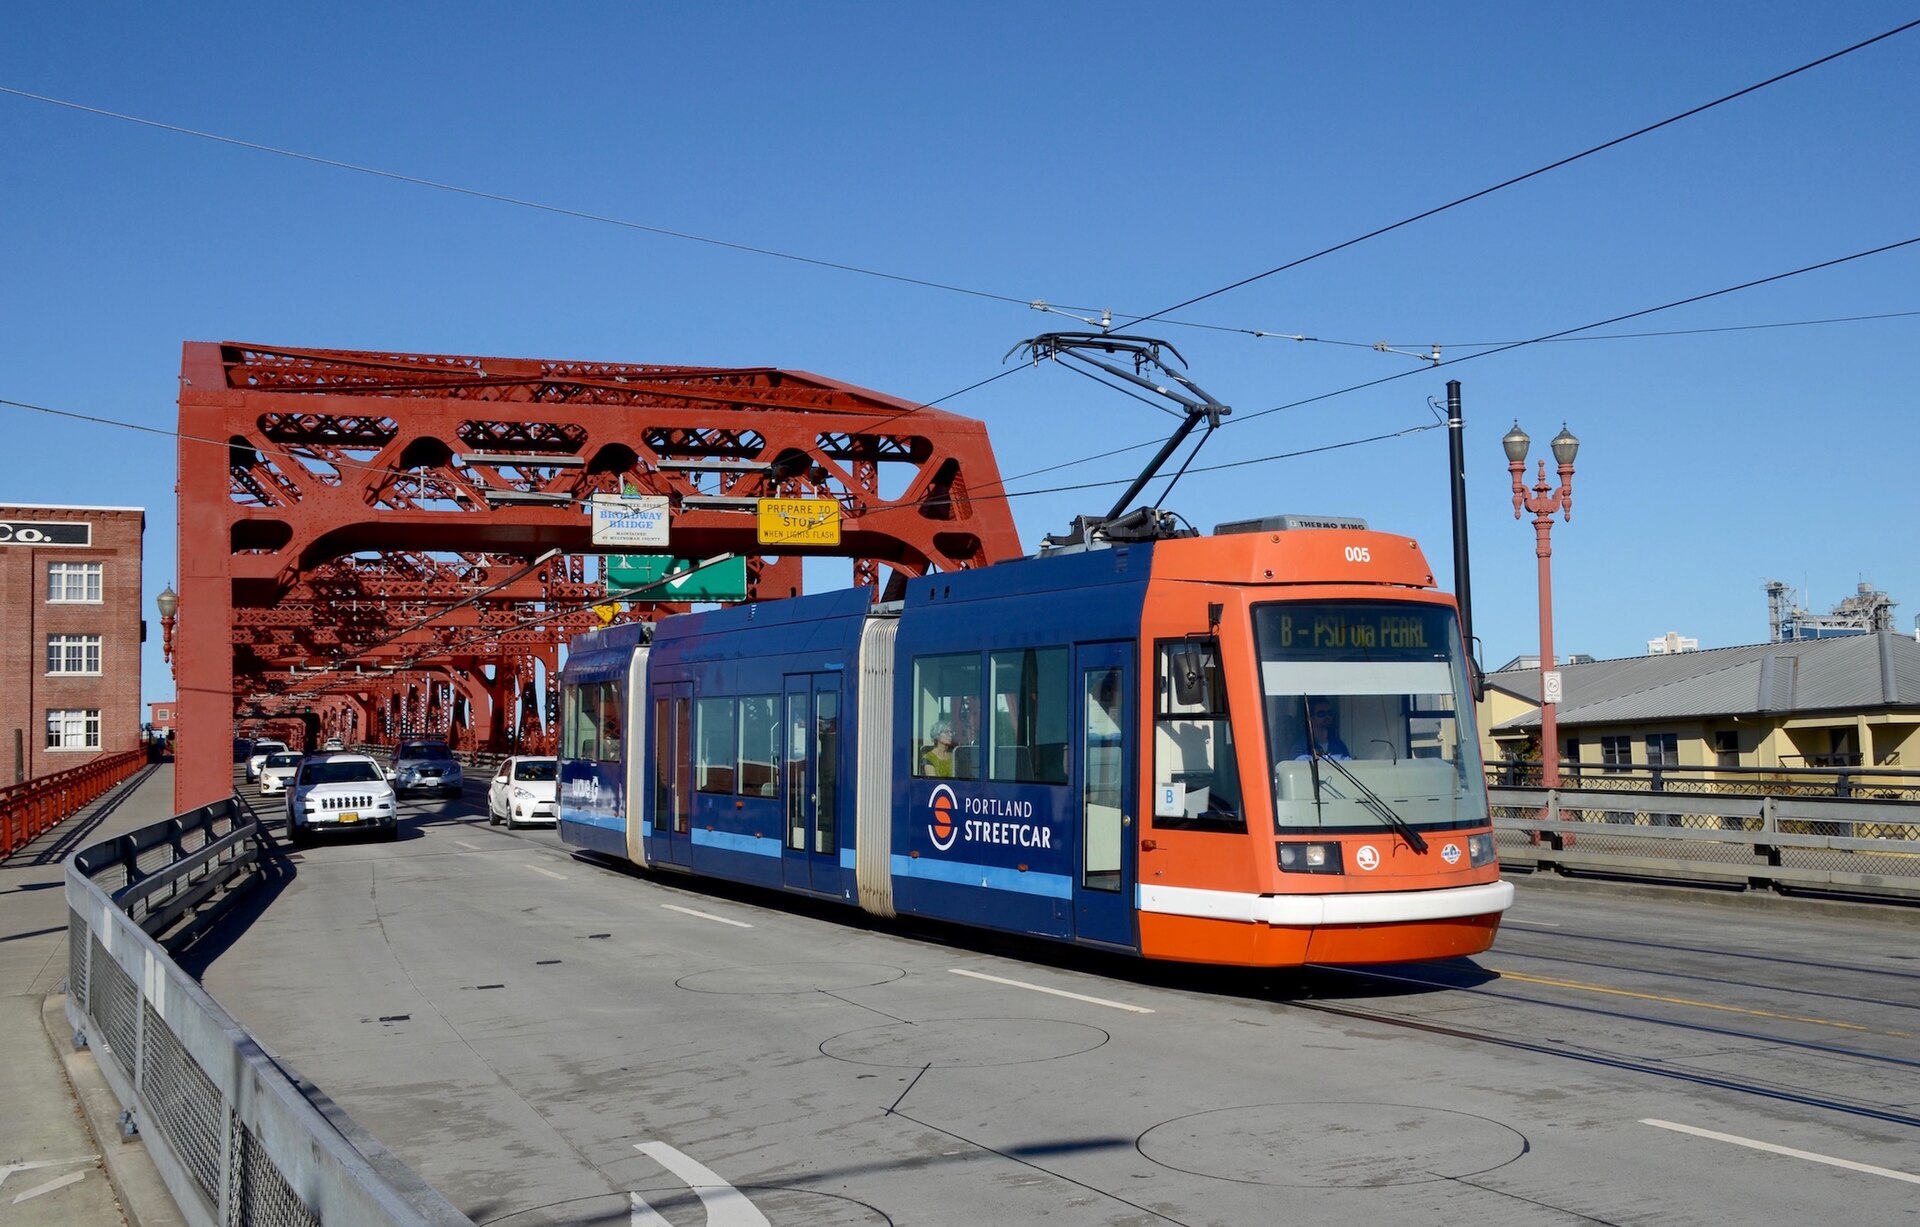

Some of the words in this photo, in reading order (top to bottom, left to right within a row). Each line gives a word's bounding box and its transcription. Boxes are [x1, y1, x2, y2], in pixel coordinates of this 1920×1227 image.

[600, 511, 662, 520] BROADWAY
[767, 504, 813, 514] PREPARE
[819, 505, 831, 514] TO
[610, 520, 654, 529] BRIDGE
[1299, 520, 1338, 529] THERMO
[1340, 523, 1365, 531] KING
[1344, 546, 1370, 563] 005
[1280, 616, 1292, 647] B
[1314, 616, 1346, 648] PSU
[1350, 616, 1375, 648] via
[1381, 616, 1428, 648] PEARL
[1166, 789, 1174, 804] B
[965, 797, 1033, 818] PORTLAND
[964, 819, 1051, 849] STREETCAR
